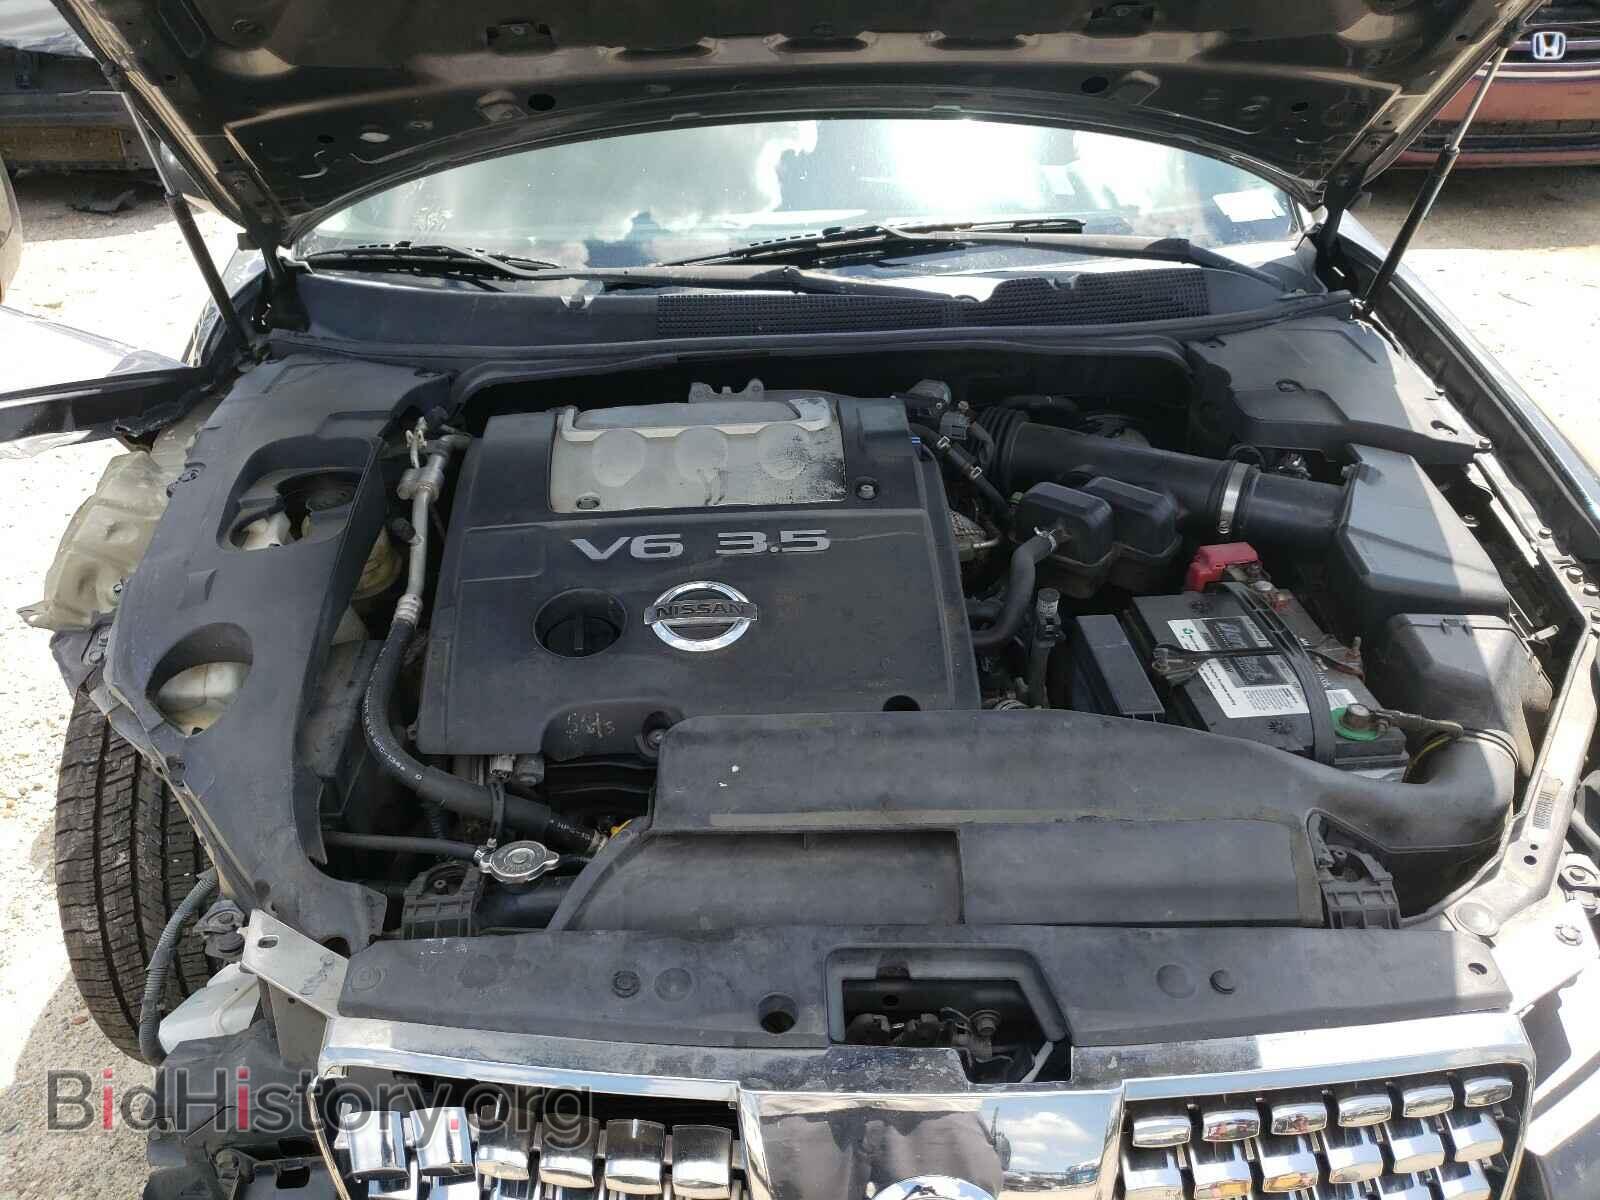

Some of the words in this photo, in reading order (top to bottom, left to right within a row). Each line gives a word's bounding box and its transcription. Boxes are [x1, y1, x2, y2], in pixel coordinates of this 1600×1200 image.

[571, 533, 684, 560] V6
[715, 530, 831, 555] 3.5
[656, 602, 747, 618] NISSAN
